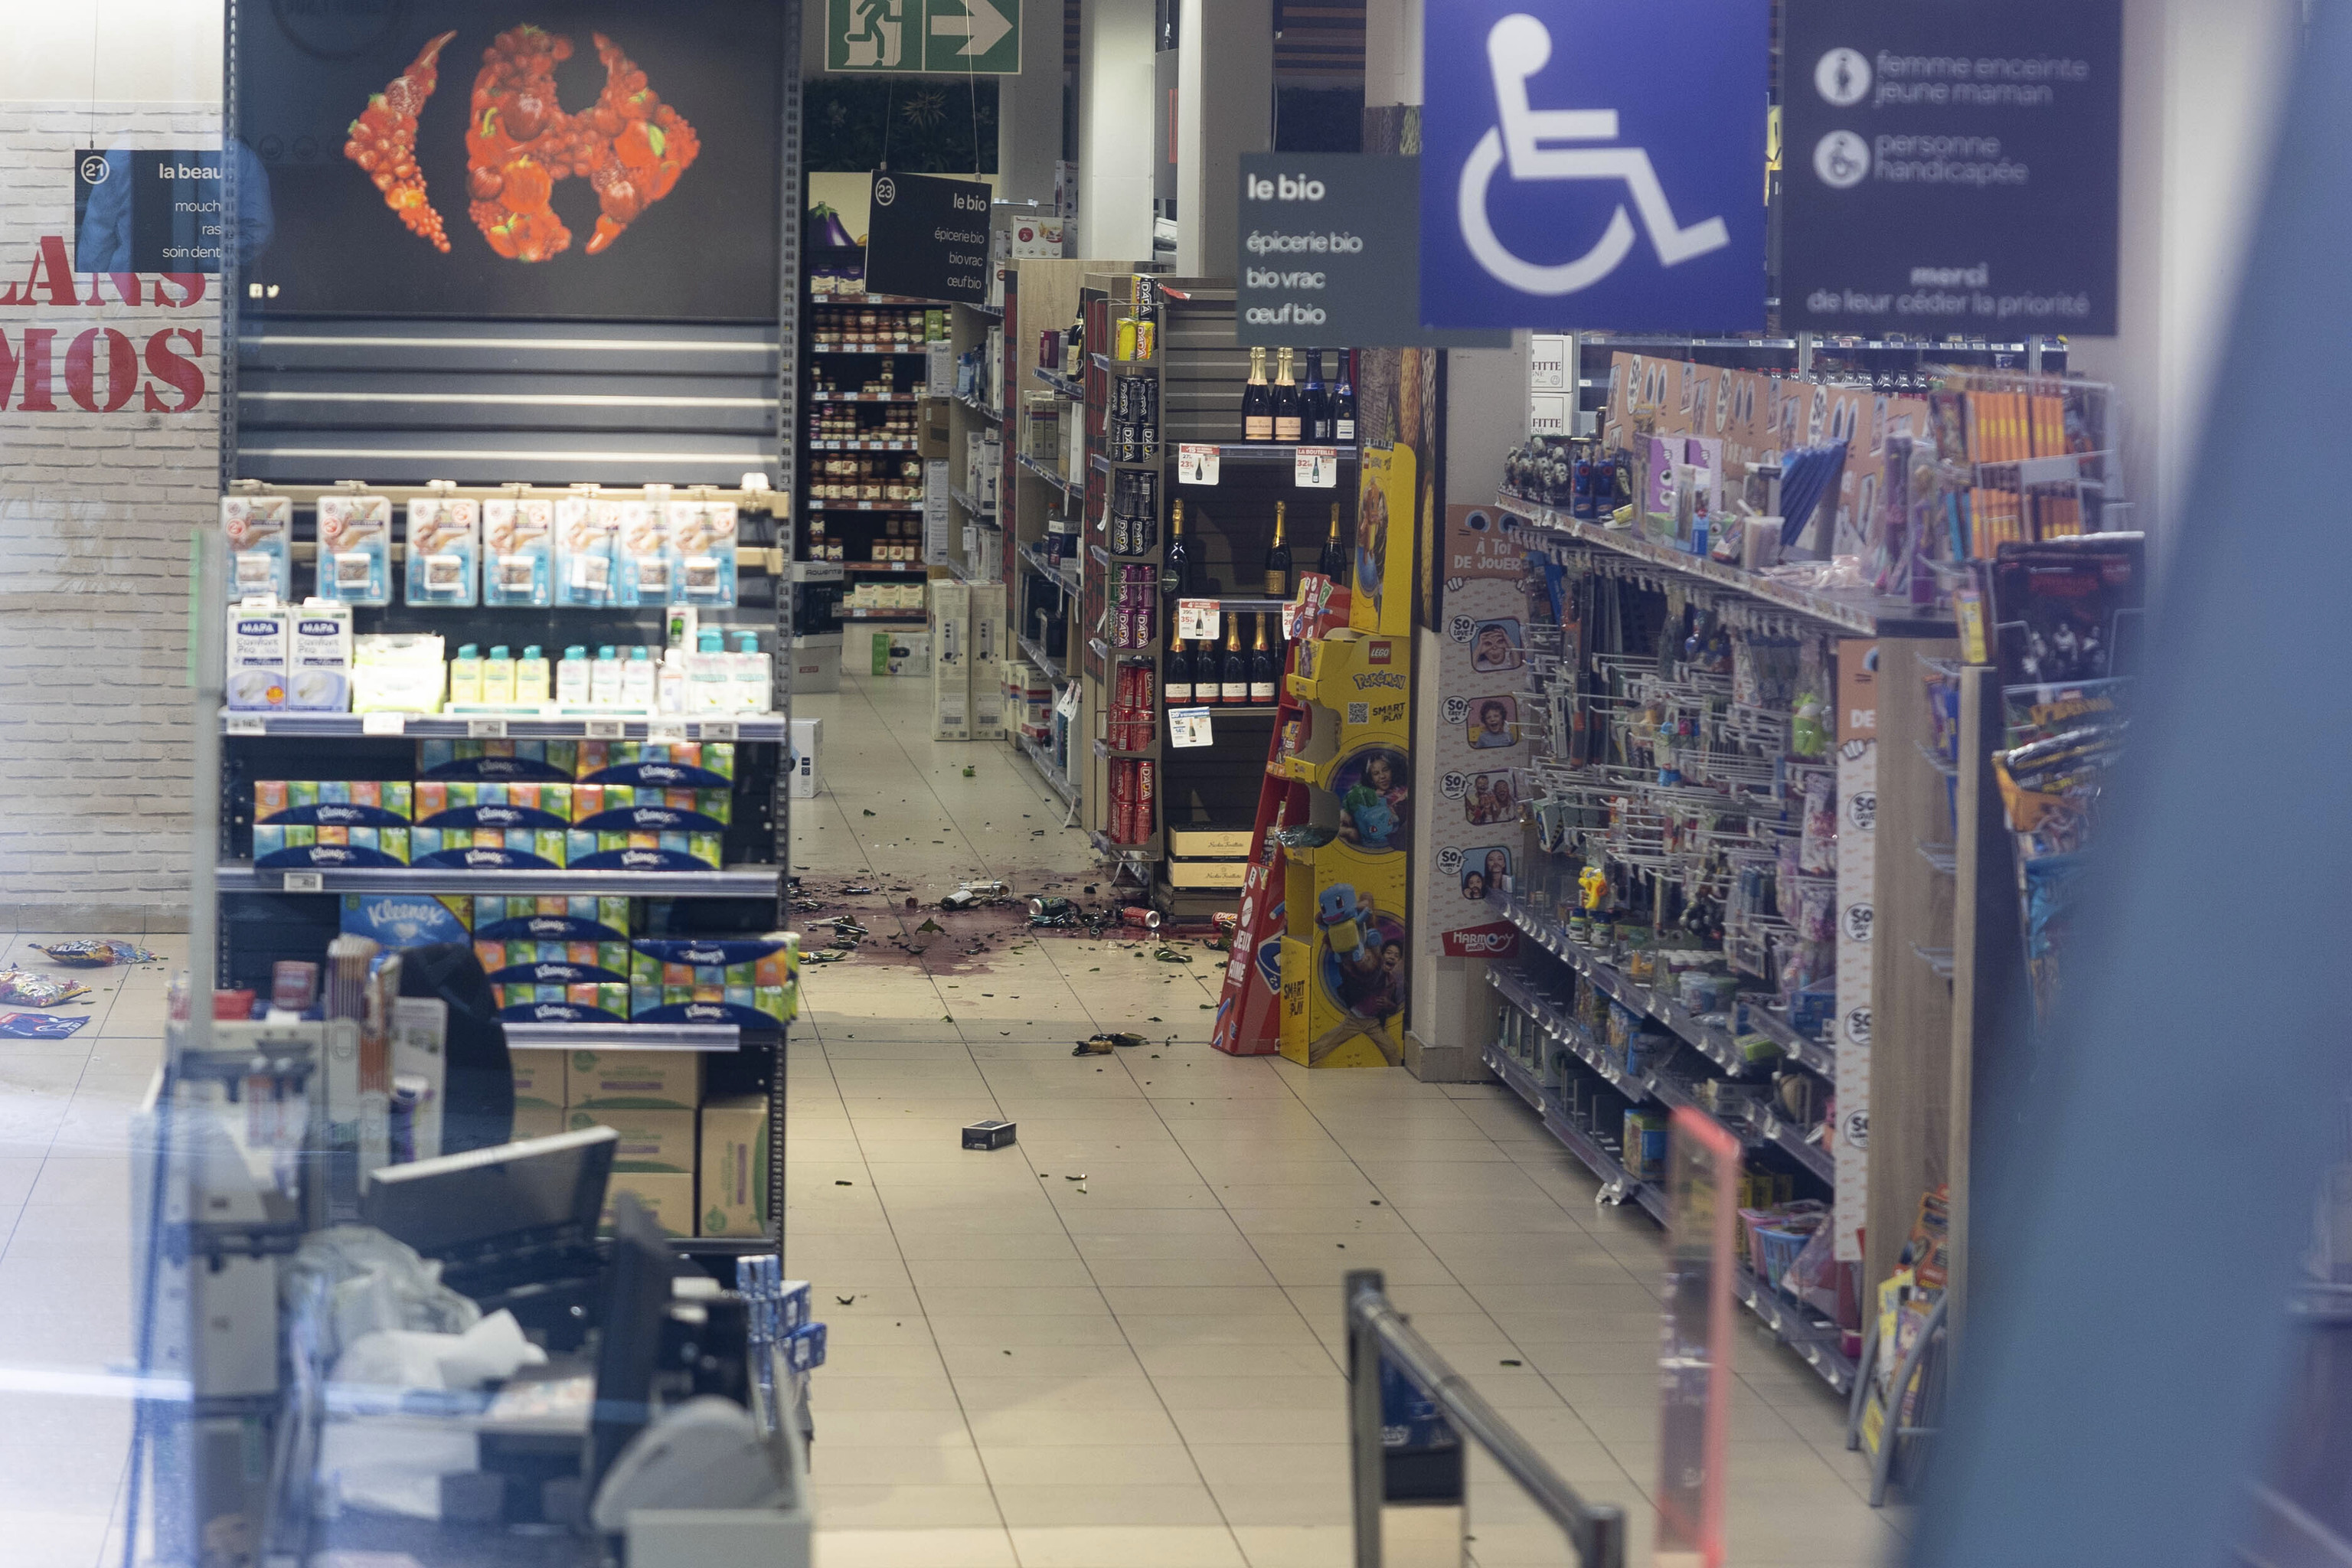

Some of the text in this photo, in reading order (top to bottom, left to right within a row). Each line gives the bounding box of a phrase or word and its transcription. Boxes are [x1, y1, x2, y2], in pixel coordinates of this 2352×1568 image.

[1876, 135, 2001, 161] personne
[86, 163, 104, 177] 21
[159, 163, 175, 179] la
[878, 185, 892, 198] 23
[1248, 173, 1325, 201] le bio
[953, 193, 986, 212] le bio
[202, 224, 220, 235] ras
[934, 227, 985, 244] épicerie bio
[1246, 230, 1363, 256] épicerie bio
[162, 246, 188, 258] soin
[949, 252, 983, 267] bio vrac
[967, 276, 982, 289] bio
[1246, 266, 1326, 289] bio vrac
[1293, 303, 1326, 325] bio
[1476, 537, 1485, 554] À
[1455, 555, 1521, 571] DE JOUER
[1371, 648, 1390, 657] LEGO
[1372, 702, 1406, 716] SMART
[1383, 712, 1403, 723] PLAY
[1850, 709, 1876, 729] DE
[368, 899, 444, 927] Kleenex
[1233, 929, 1253, 952] JEUX
